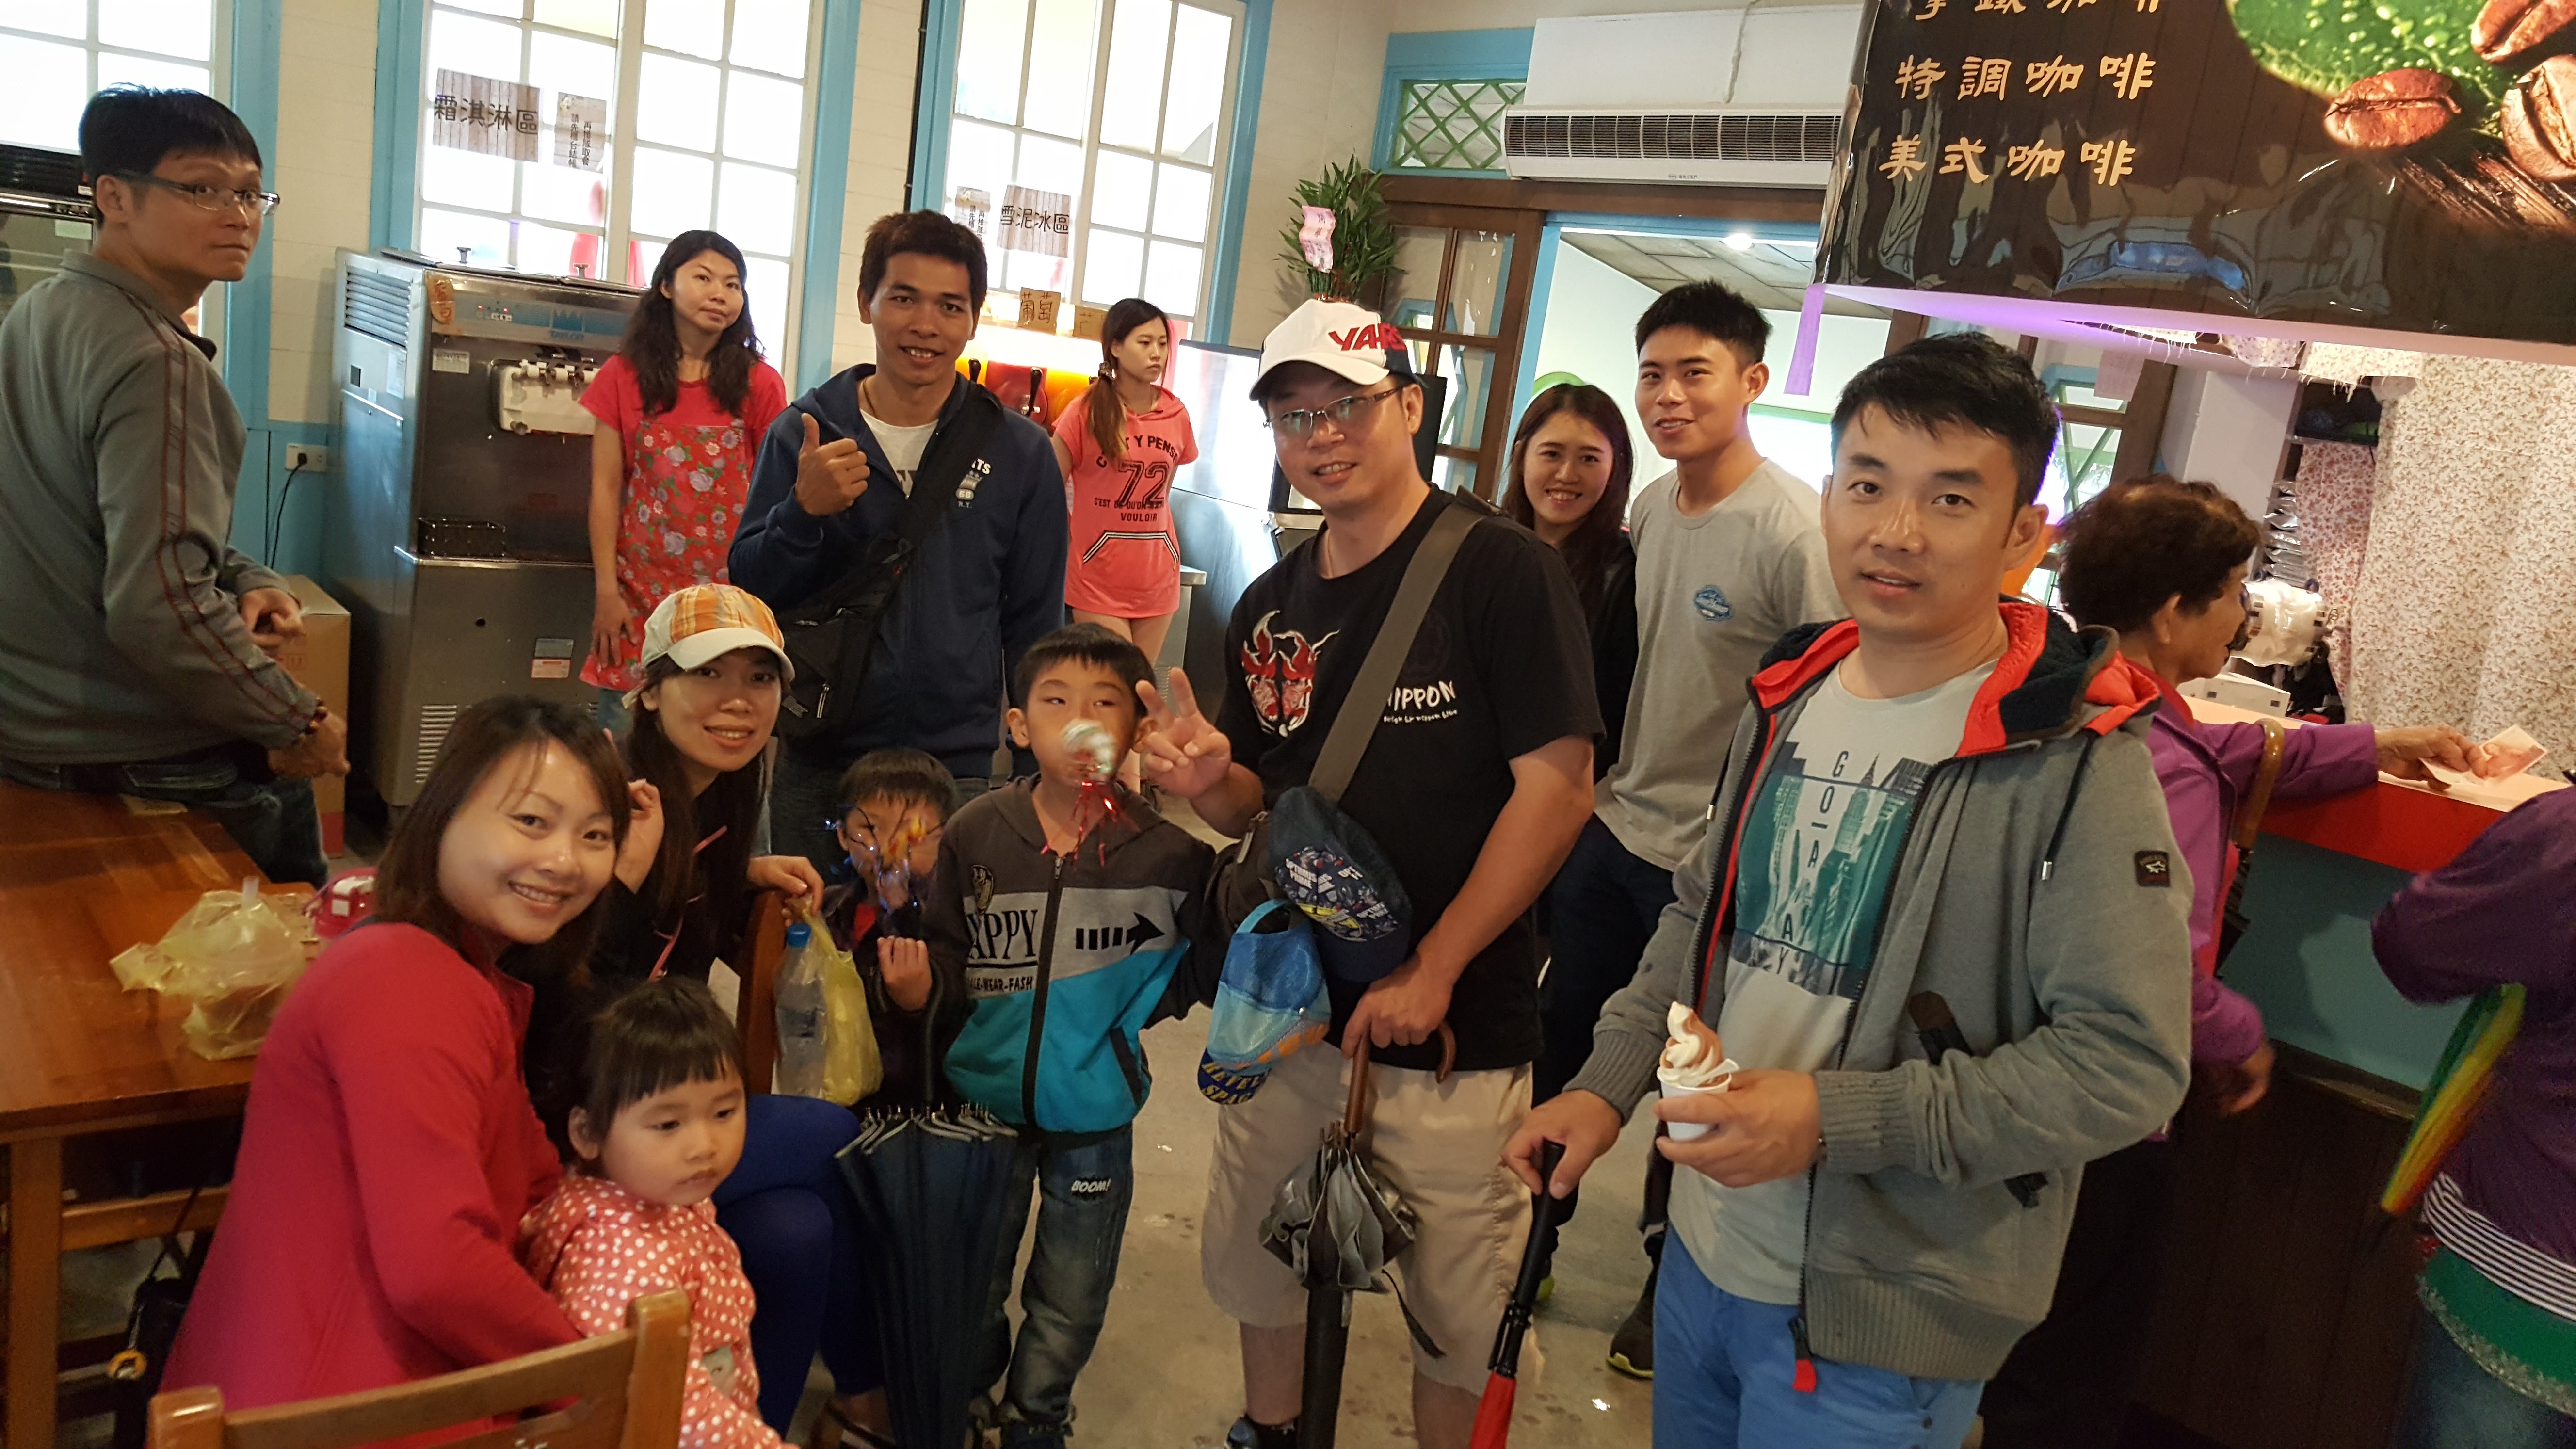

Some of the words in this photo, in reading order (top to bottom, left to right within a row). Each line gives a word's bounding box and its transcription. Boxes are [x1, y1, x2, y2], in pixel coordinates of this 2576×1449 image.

[1895, 52, 2156, 101] 特調咖啡
[434, 94, 538, 135] 霜淇淋區
[1879, 134, 2136, 186] 美式咖啡
[1000, 205, 1070, 234] 雪泥冰區
[1021, 291, 1053, 324] 葡萄
[1118, 460, 1170, 508] 72
[1121, 513, 1158, 522] VOULOIR
[1071, 1177, 1111, 1193] BOOM!
